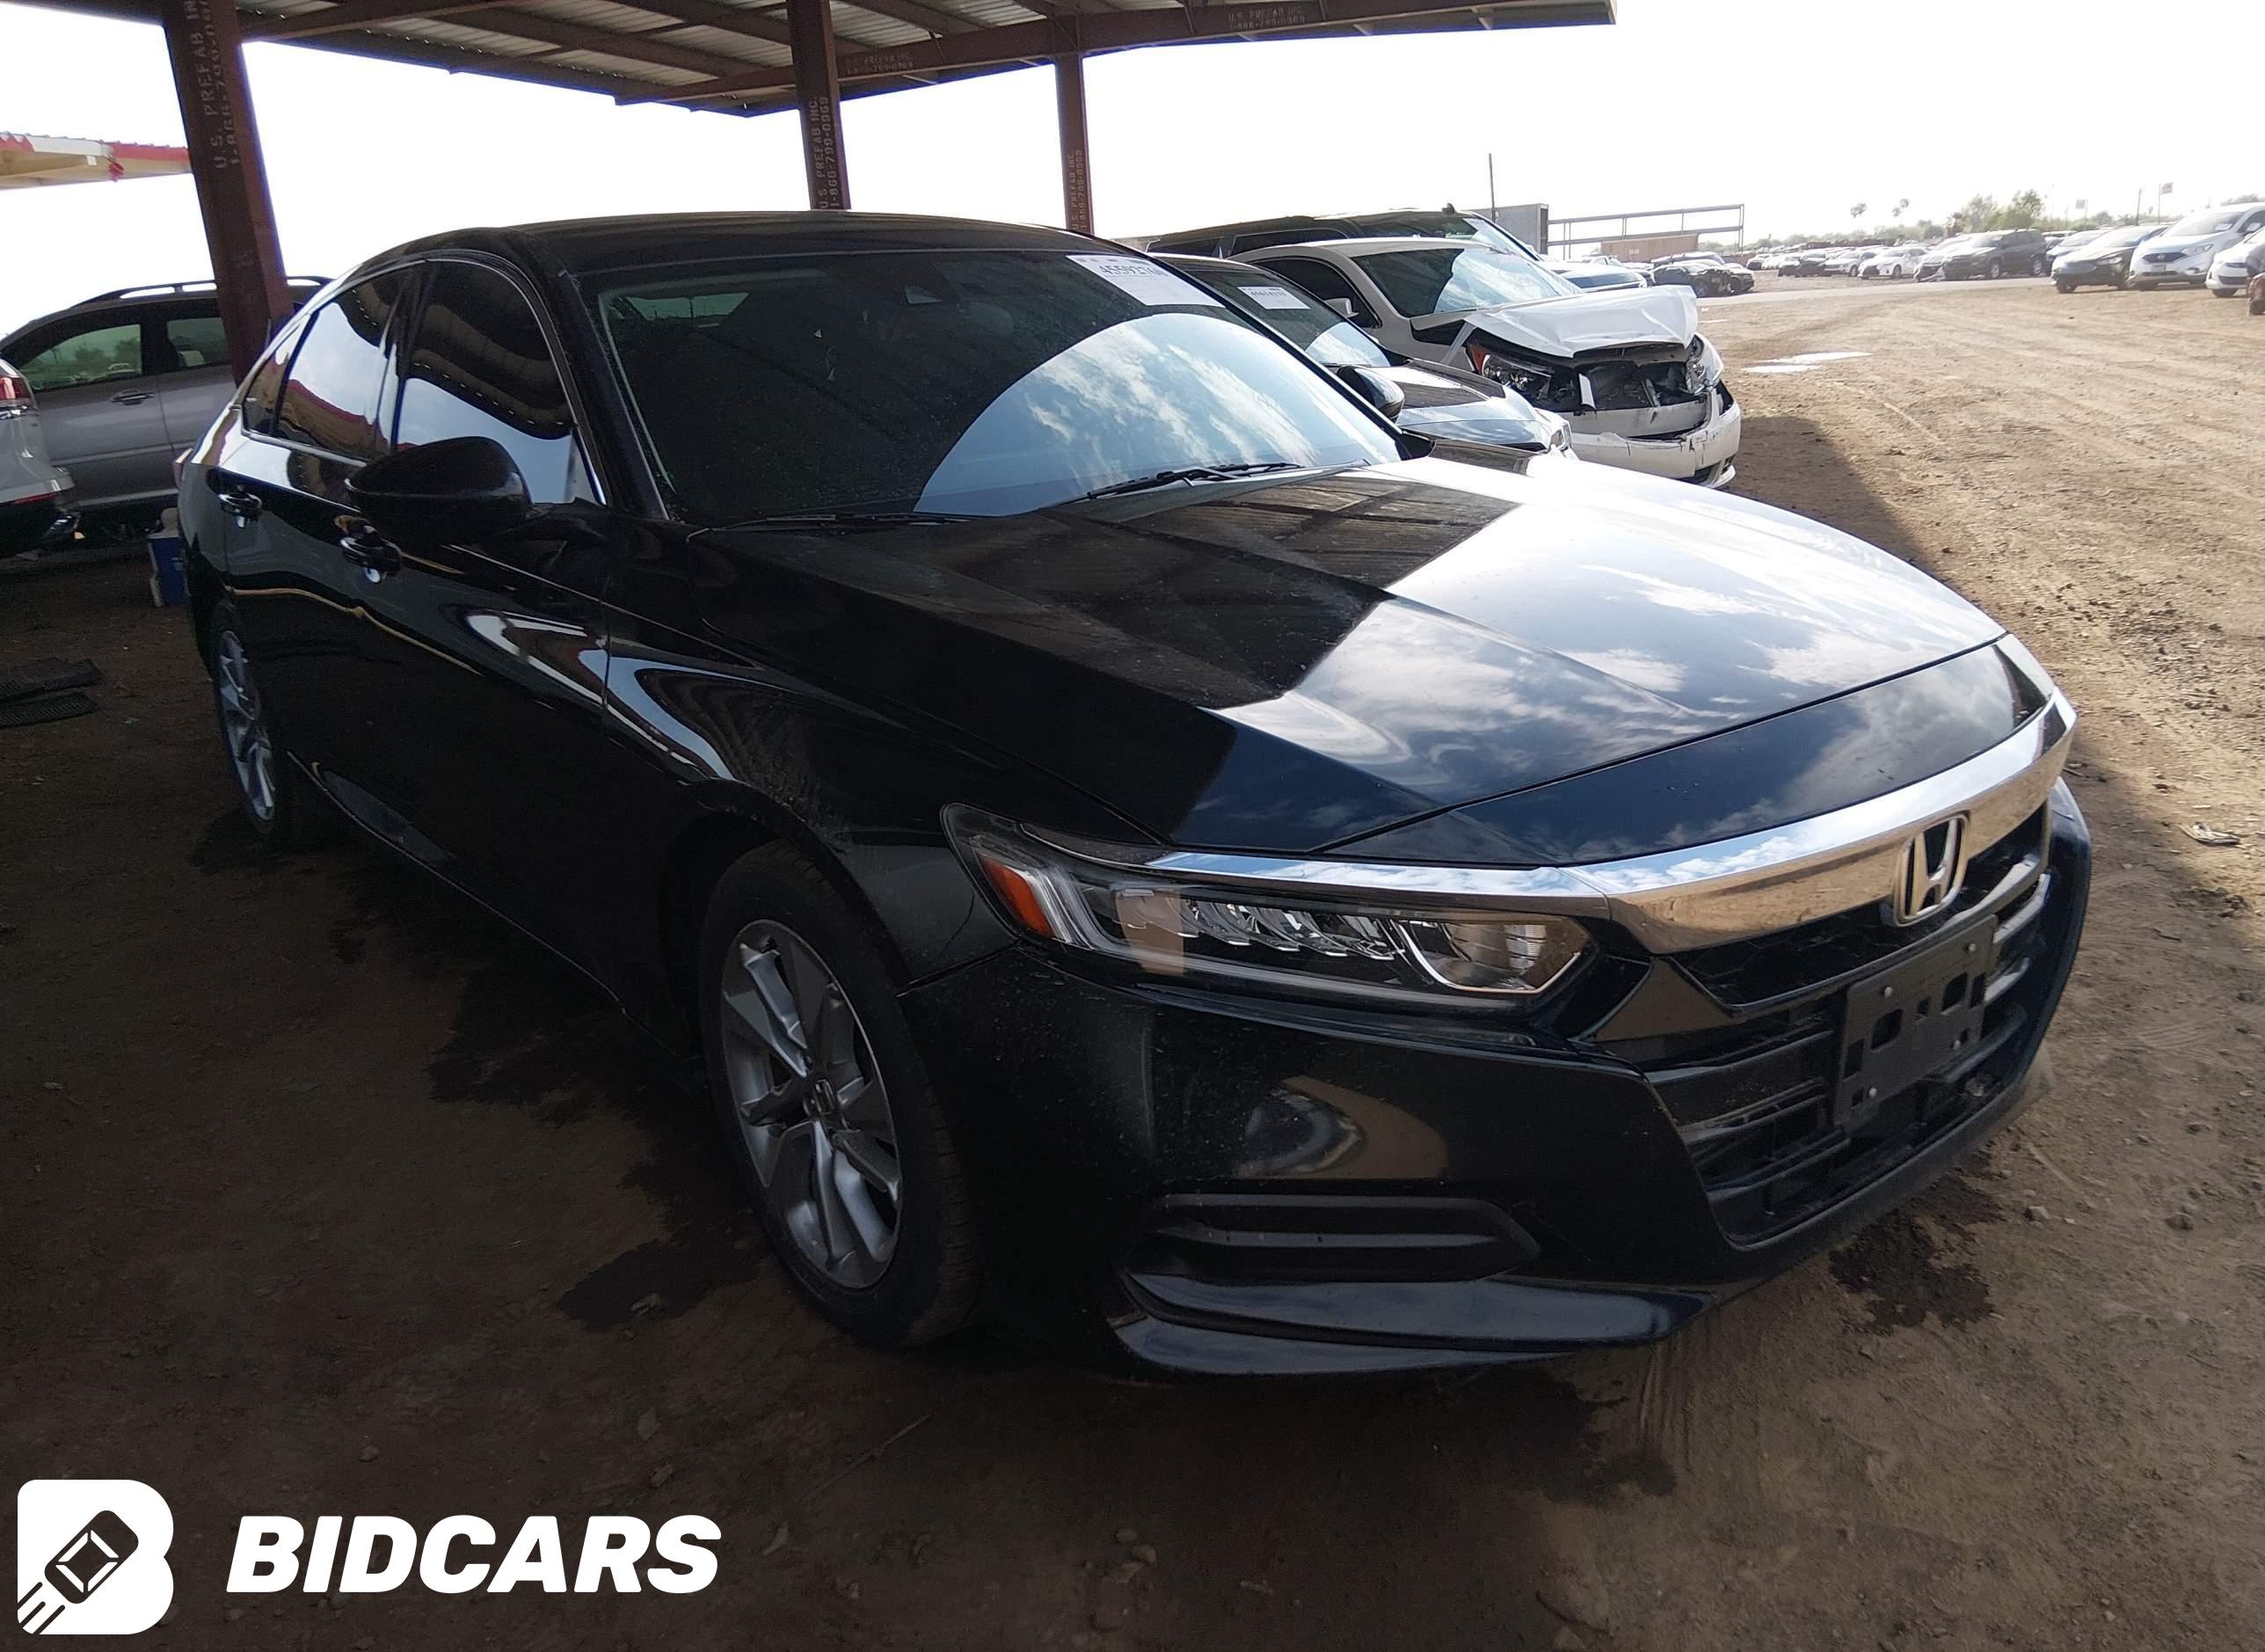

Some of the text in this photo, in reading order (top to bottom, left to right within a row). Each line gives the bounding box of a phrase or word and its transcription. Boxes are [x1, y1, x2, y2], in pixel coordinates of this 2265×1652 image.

[190, 33, 219, 115] PREFAB
[809, 97, 819, 121] INC.
[811, 127, 826, 178] PREFAB
